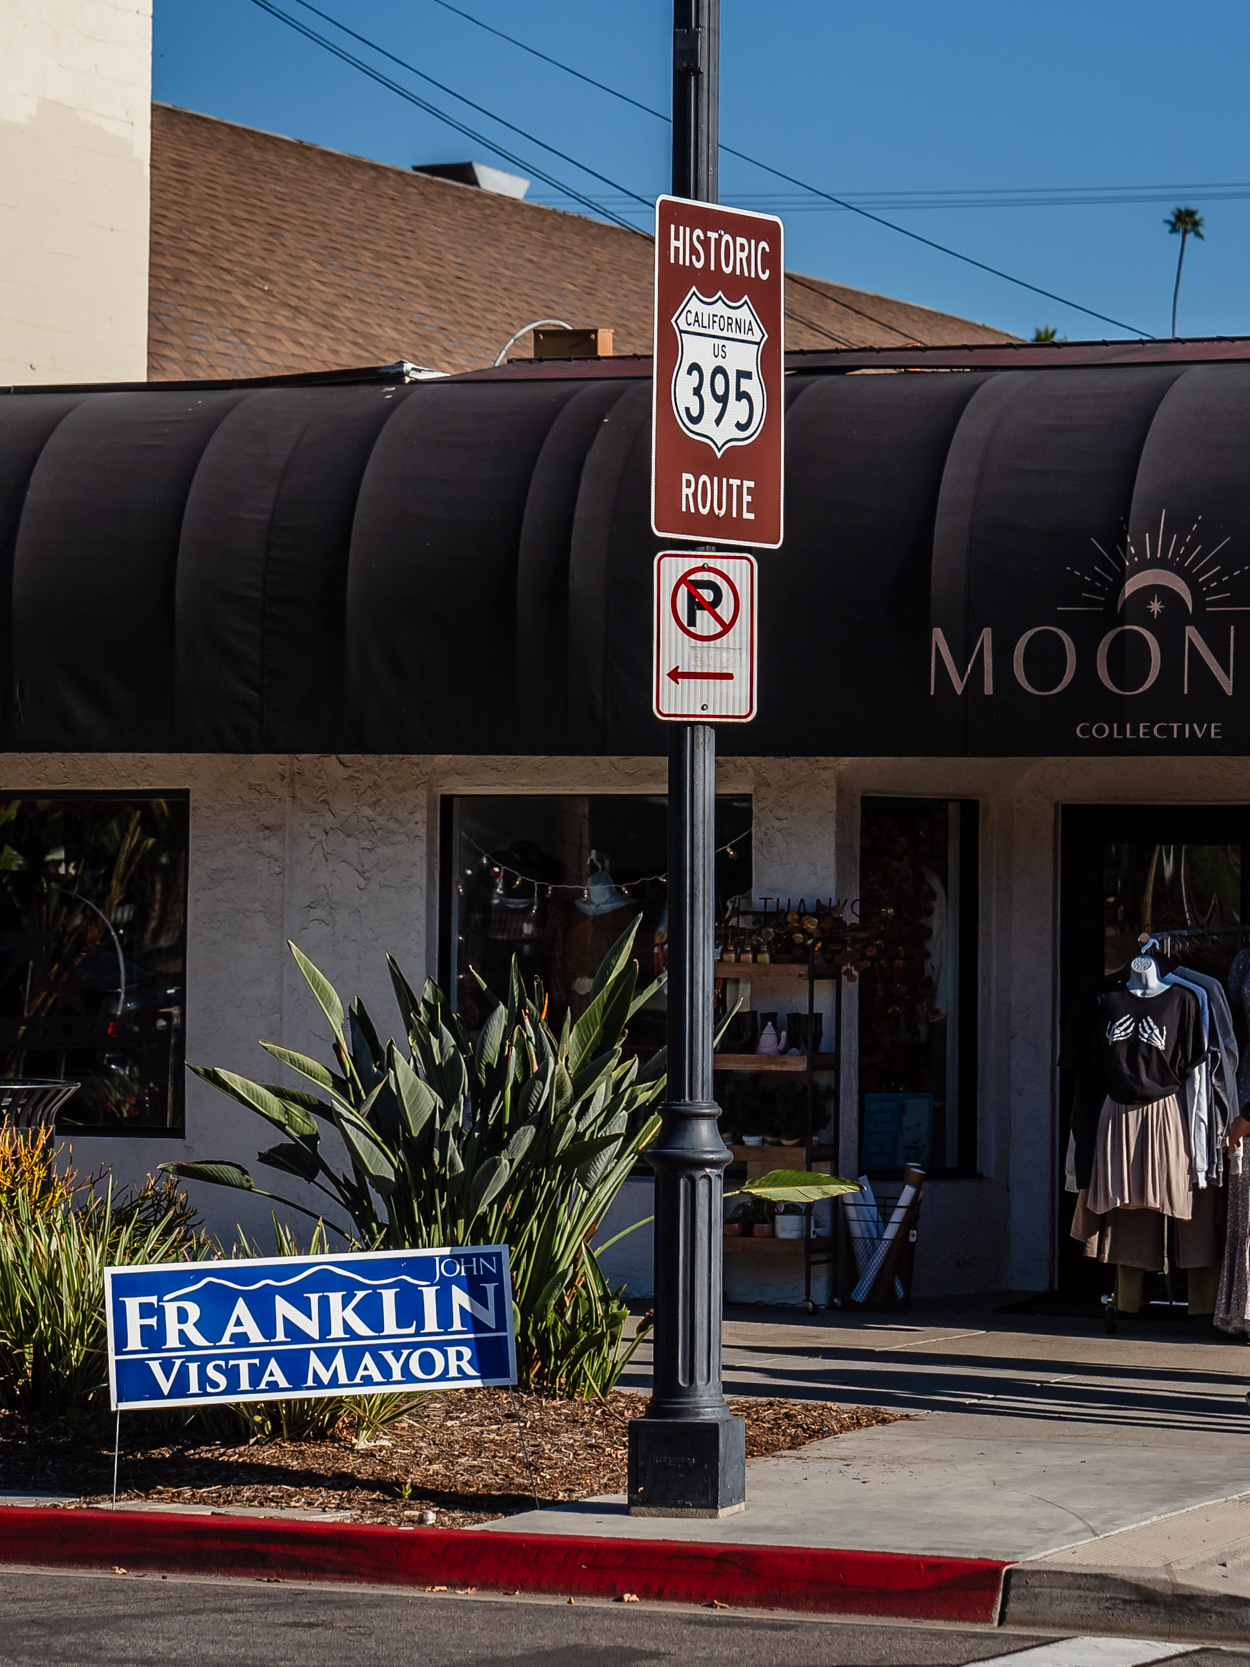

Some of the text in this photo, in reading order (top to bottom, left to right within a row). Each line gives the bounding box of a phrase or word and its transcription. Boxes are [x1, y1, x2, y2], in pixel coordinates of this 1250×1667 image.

[669, 223, 771, 281] HISTORIC
[684, 308, 756, 337] CALIFORNIA
[711, 342, 727, 360] US
[684, 363, 755, 433] 395
[681, 472, 755, 520] ROUTE
[1075, 722, 1222, 739] COLLECTIVE
[433, 1256, 497, 1284] JOHN
[119, 1284, 499, 1352] FRANKLIN
[144, 1346, 481, 1396] VISTA MAYOR
